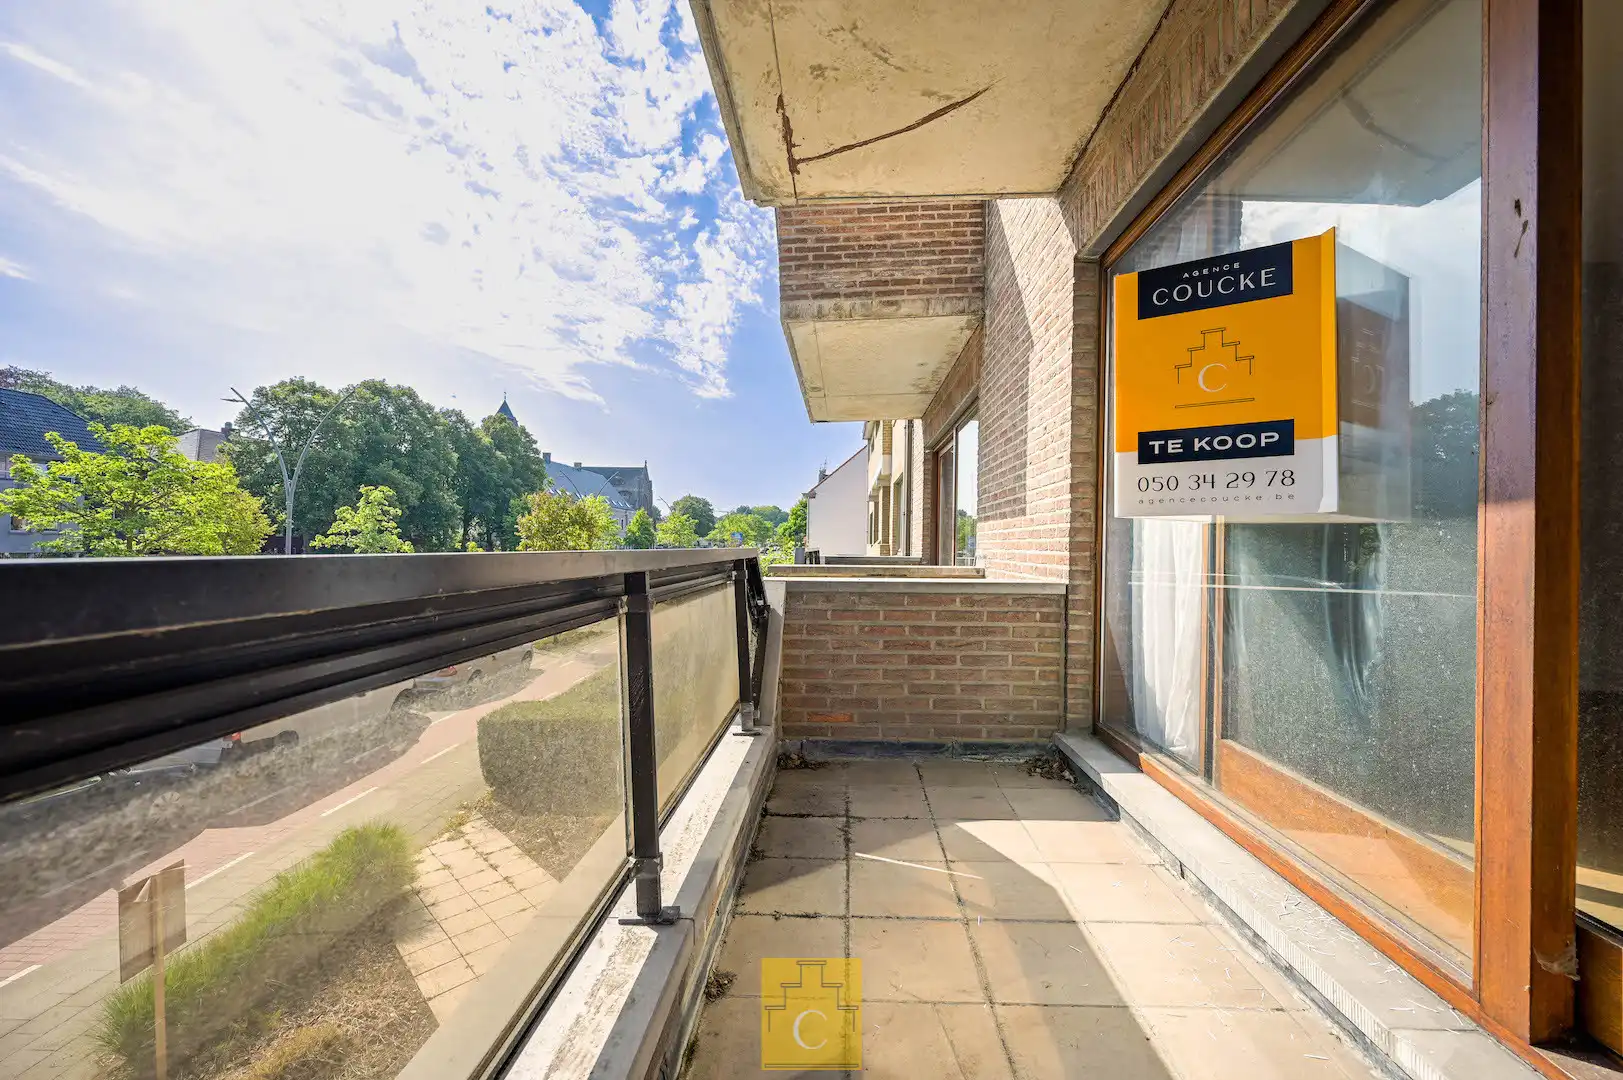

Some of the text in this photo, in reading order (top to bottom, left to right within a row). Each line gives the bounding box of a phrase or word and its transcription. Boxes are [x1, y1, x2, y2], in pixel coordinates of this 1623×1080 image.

[1182, 262, 1240, 278] AGENCE
[1152, 267, 1276, 306] COUCKE
[1197, 363, 1227, 392] C
[1149, 432, 1280, 455] TE KOOP
[1137, 469, 1295, 492] 050 34 29 78
[1138, 493, 1295, 505] agencecoucke.be
